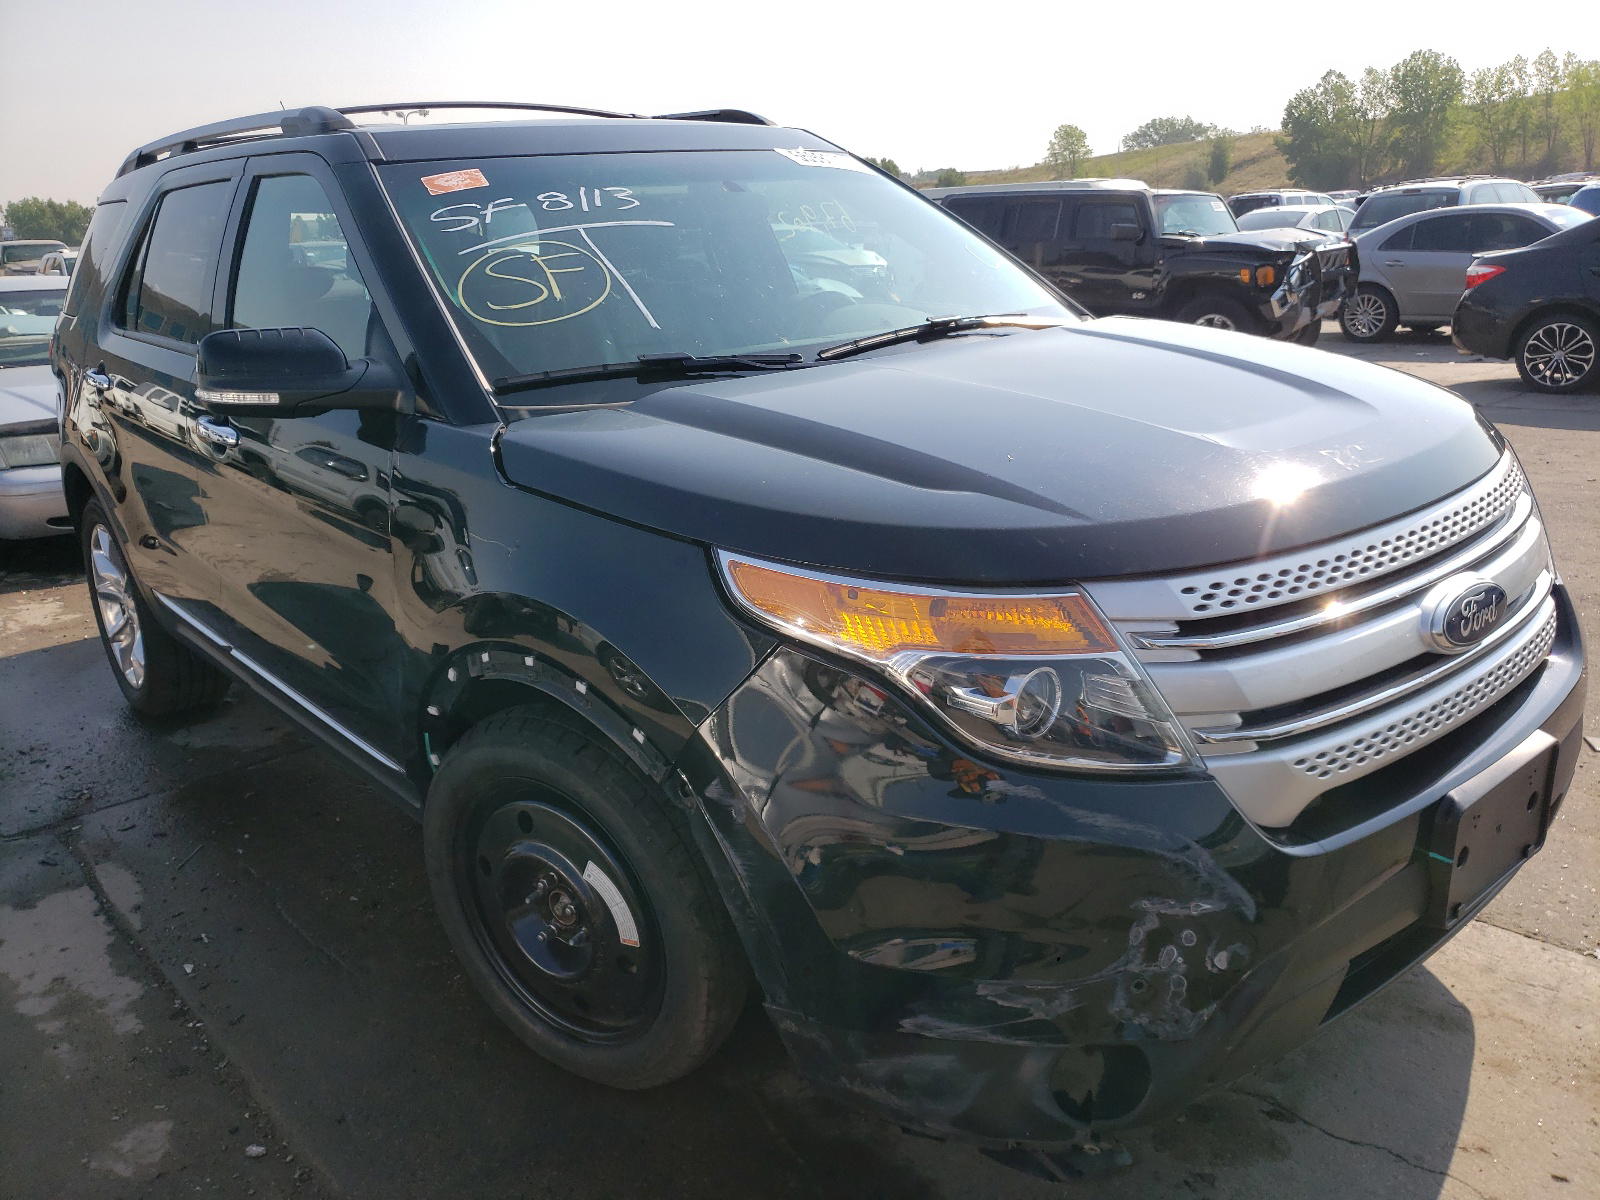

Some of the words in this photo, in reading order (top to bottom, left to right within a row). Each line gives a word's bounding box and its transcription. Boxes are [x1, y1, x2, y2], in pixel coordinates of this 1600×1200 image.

[430, 197, 528, 232] SF
[484, 252, 585, 310] SF
[1460, 591, 1498, 637] Ford
